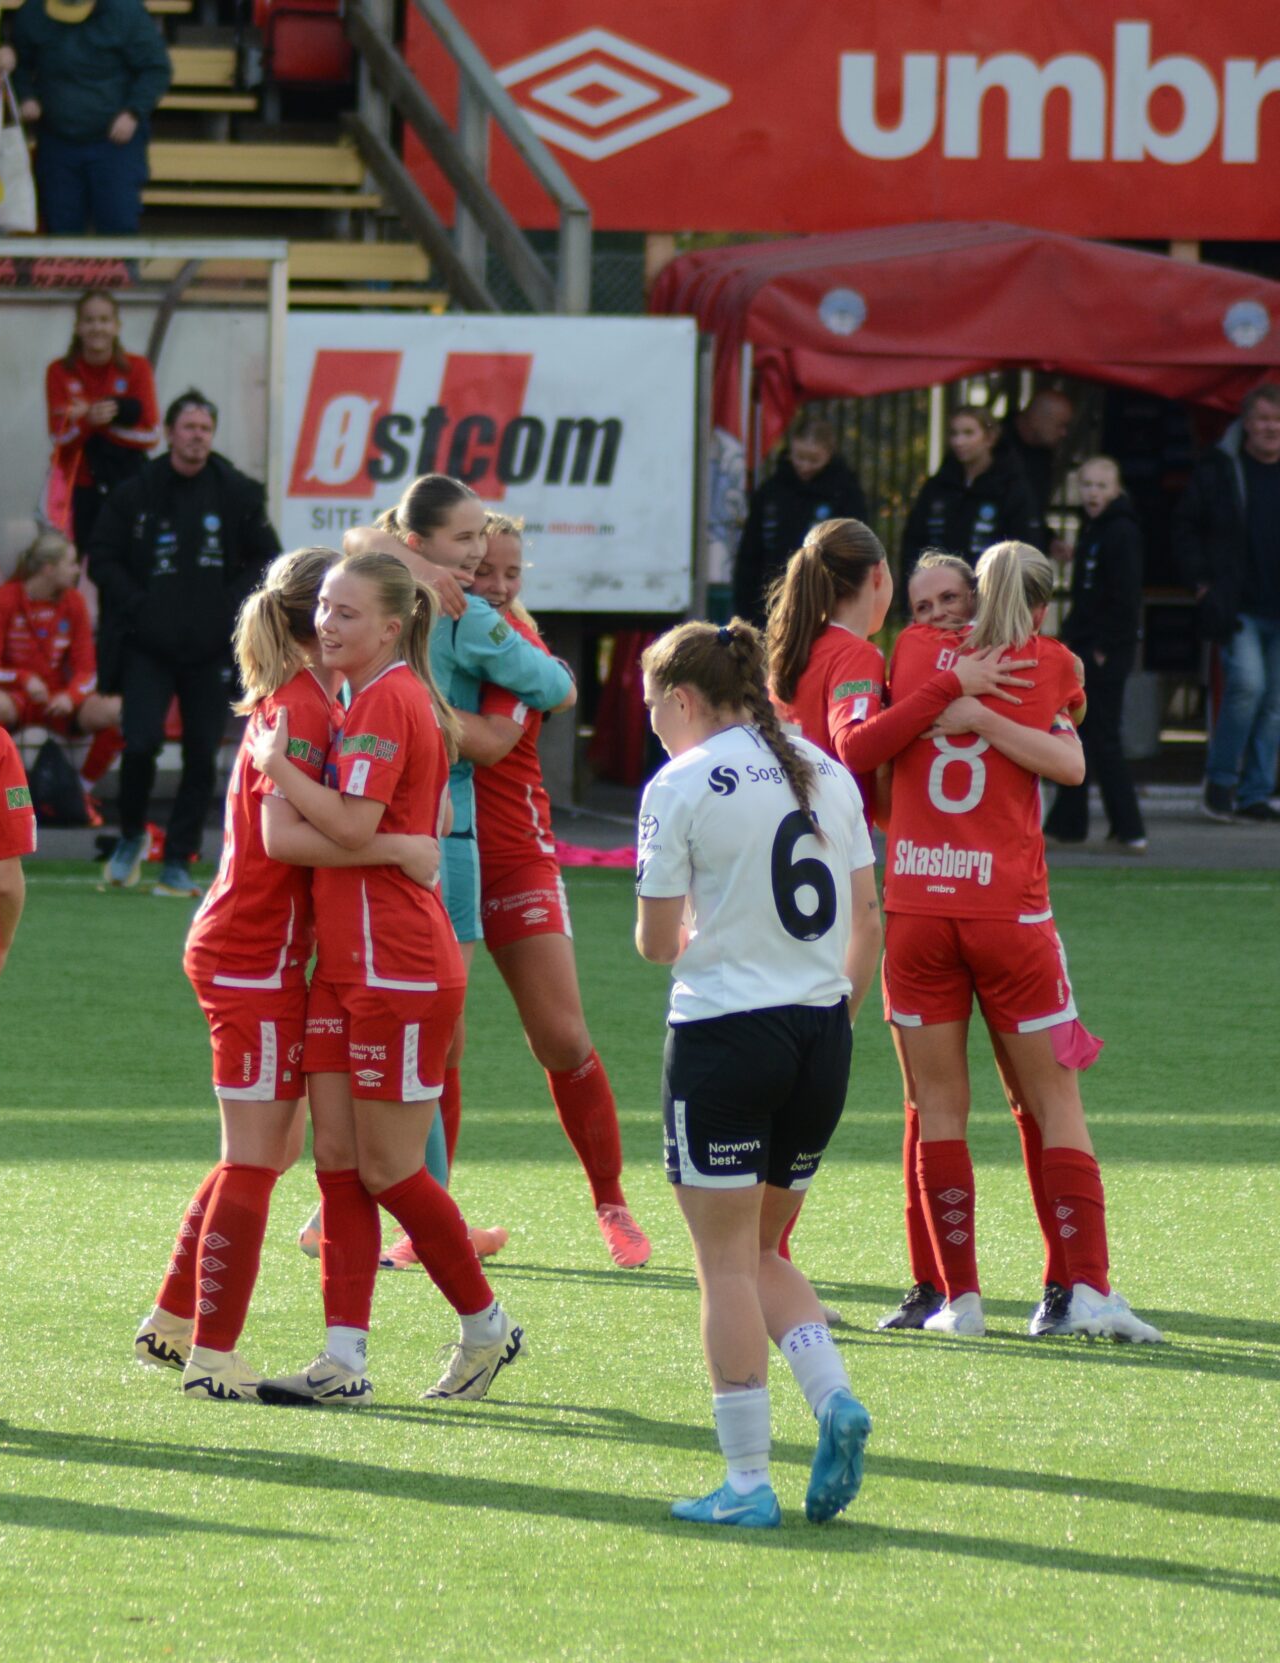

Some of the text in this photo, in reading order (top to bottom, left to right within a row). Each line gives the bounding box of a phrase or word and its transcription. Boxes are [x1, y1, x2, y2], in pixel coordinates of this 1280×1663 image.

[311, 507, 362, 530] SITE
[927, 735, 990, 814] 8
[893, 839, 993, 886] Skasberg
[770, 809, 838, 942] 6
[926, 884, 957, 894] umbro
[327, 1025, 344, 1034] AS
[370, 1051, 387, 1060] AS
[242, 1052, 252, 1082] umbro
[358, 1079, 382, 1088] umbro
[708, 1139, 761, 1154] Norway's
